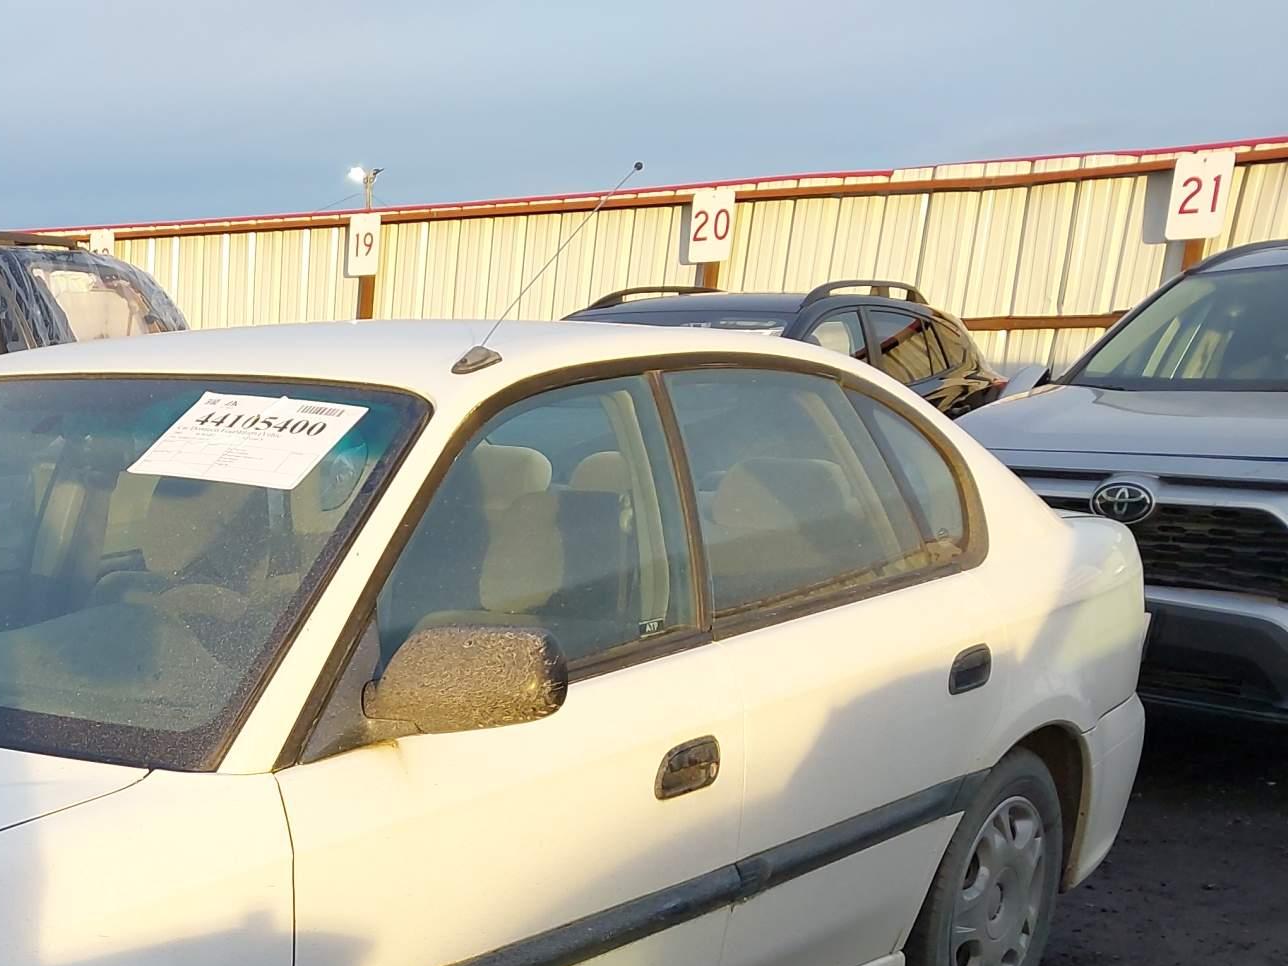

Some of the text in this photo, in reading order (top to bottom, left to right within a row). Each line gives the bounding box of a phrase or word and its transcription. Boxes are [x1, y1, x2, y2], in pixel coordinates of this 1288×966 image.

[1178, 174, 1222, 214] 21
[693, 208, 730, 242] 20
[355, 232, 374, 257] 19
[195, 411, 328, 438] 44105400
